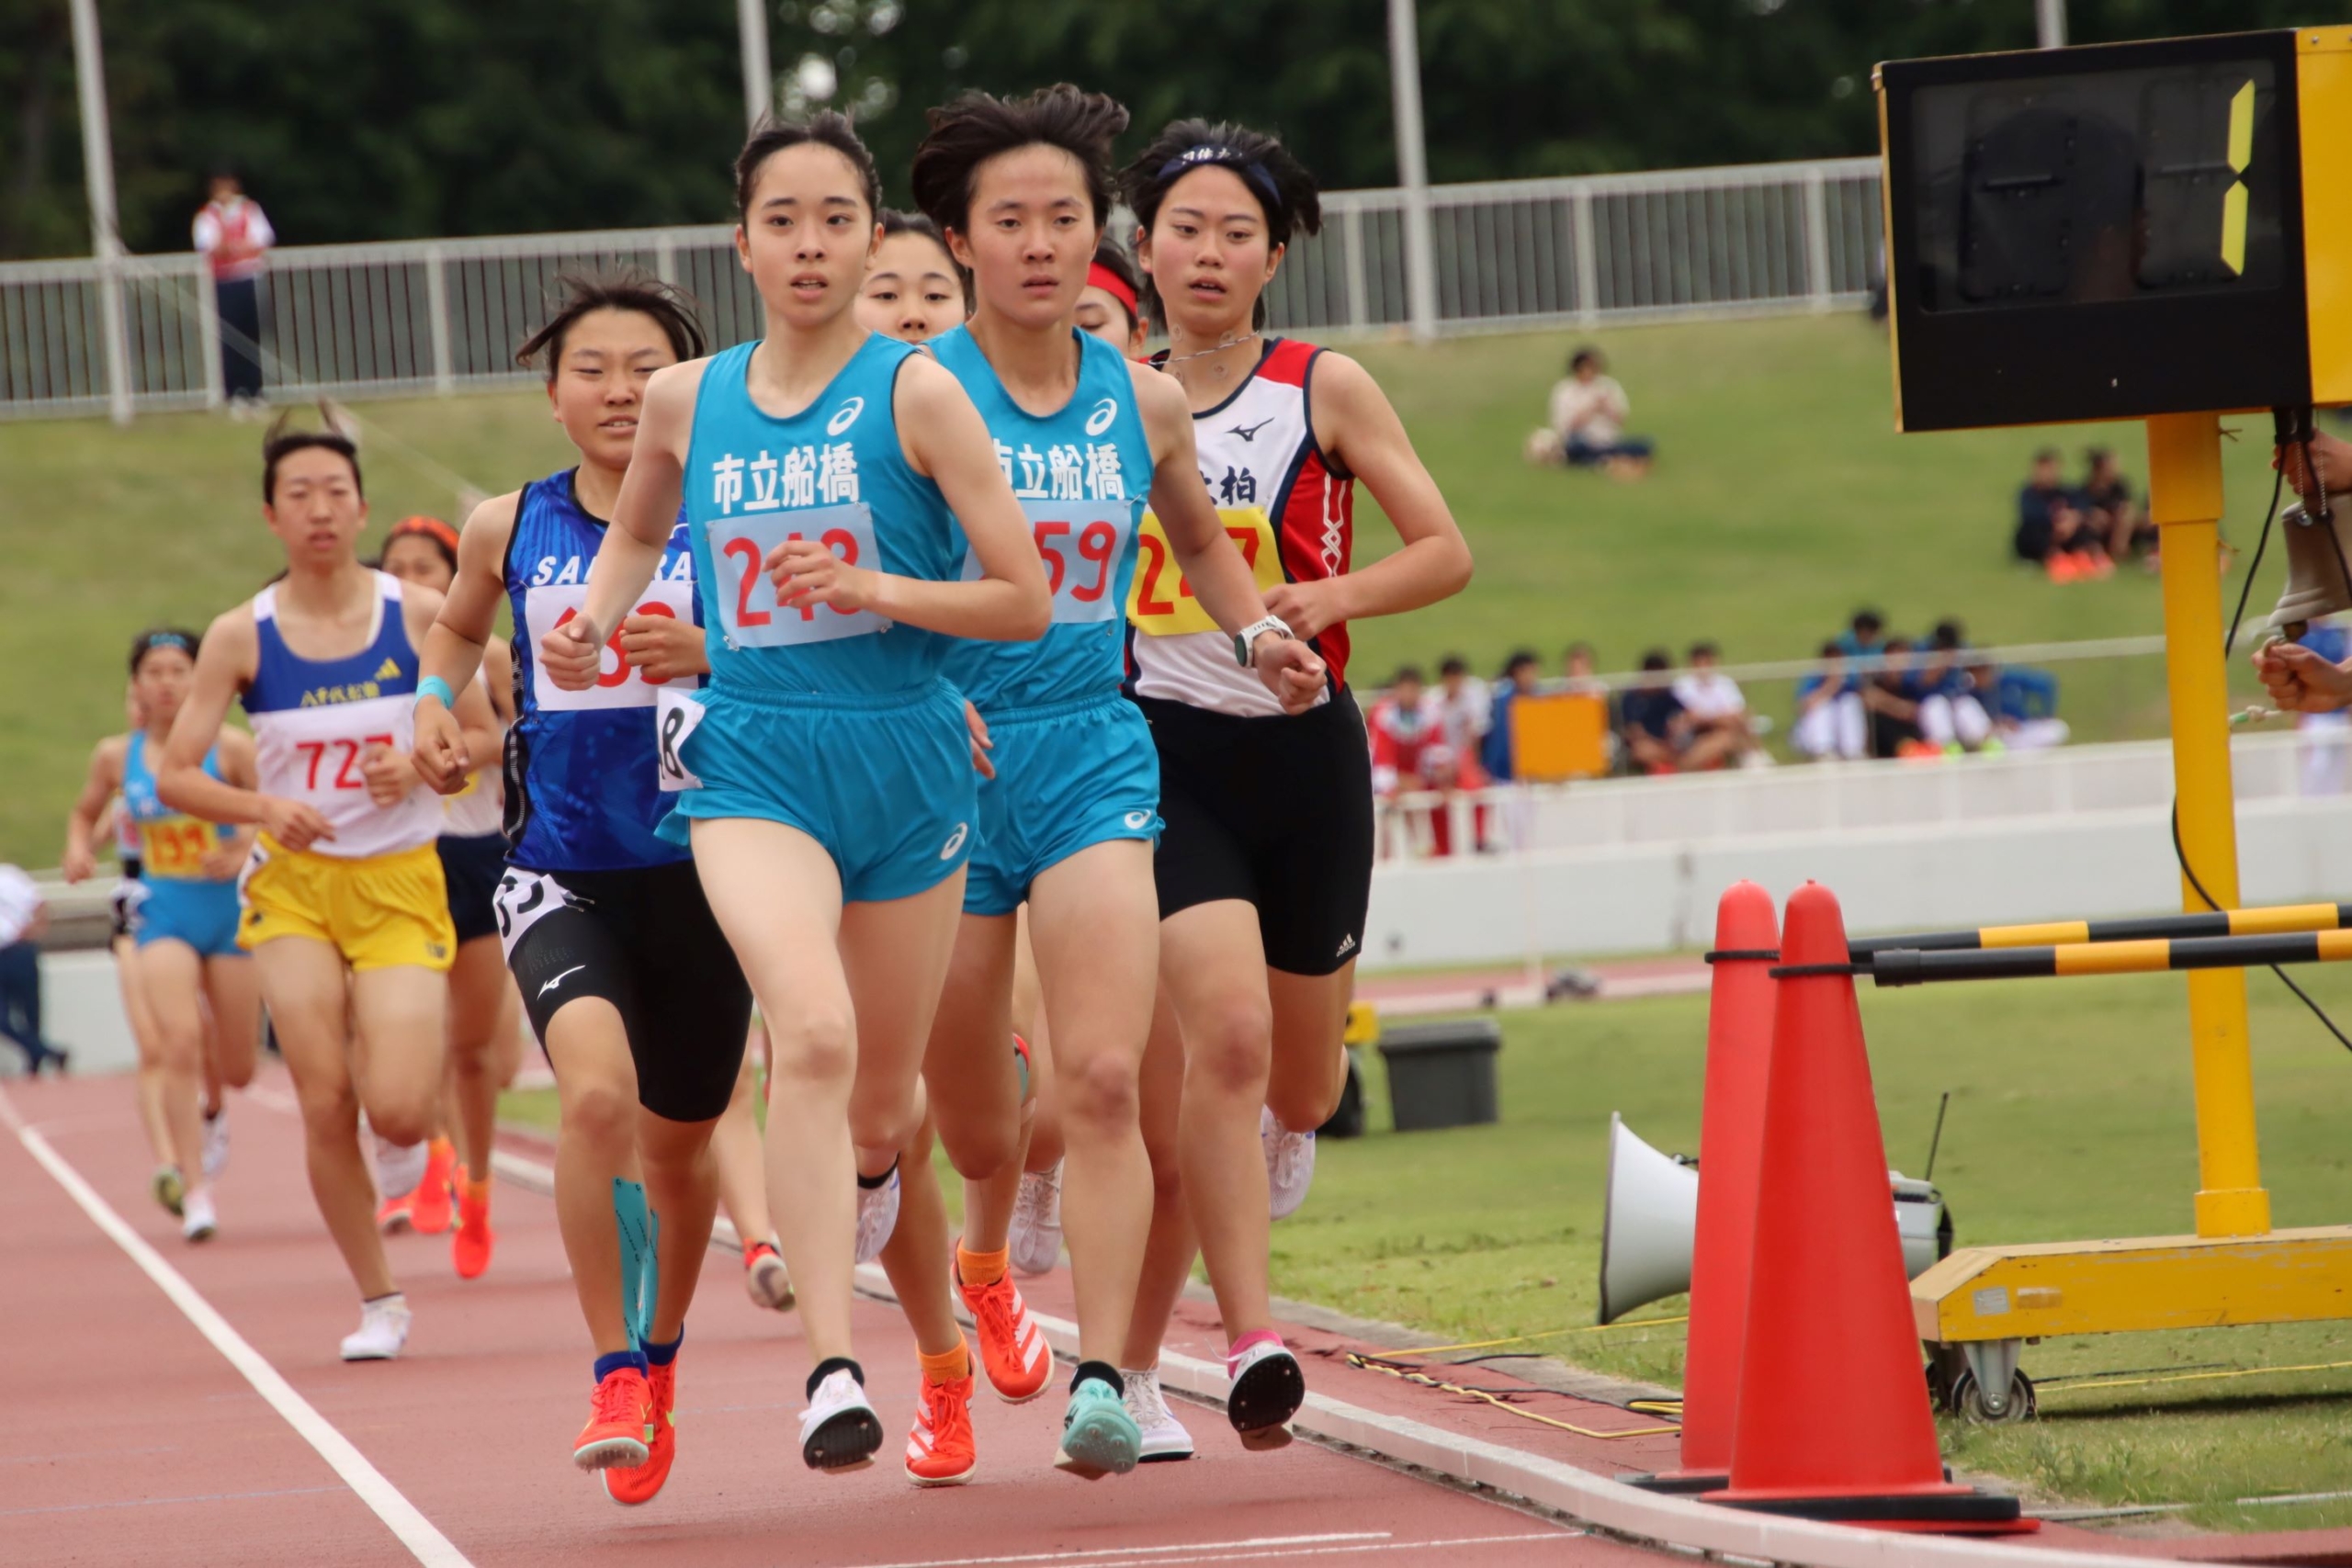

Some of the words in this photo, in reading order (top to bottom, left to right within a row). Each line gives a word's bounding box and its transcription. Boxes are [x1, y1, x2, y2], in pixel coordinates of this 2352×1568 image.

[2221, 79, 2256, 276] 1
[712, 442, 860, 514] 市立船橋
